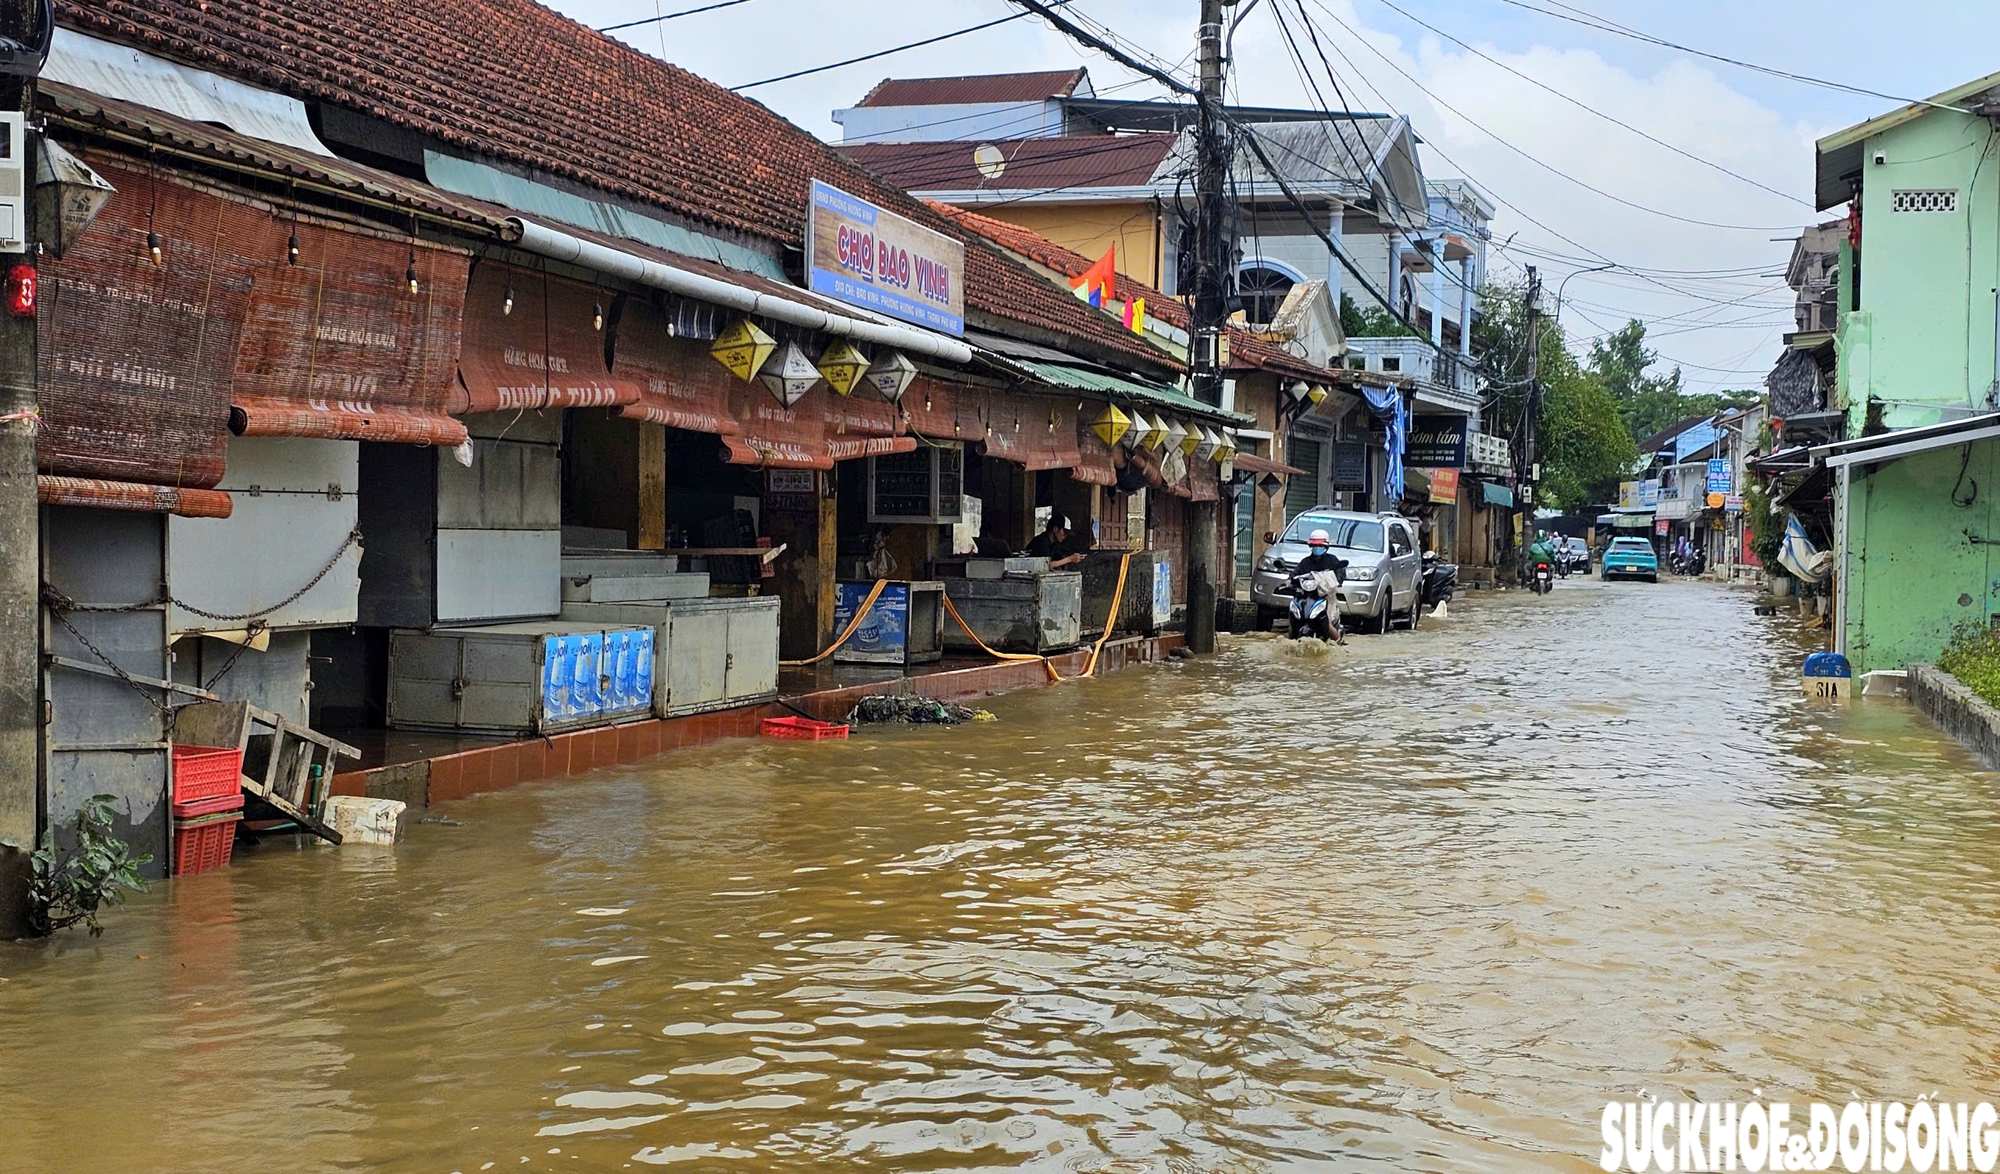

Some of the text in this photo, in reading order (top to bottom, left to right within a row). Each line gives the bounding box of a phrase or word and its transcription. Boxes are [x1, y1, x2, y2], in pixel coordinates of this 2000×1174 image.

[837, 223, 950, 304] CHỢ BAO VINH
[1435, 426, 1463, 445] tấm
